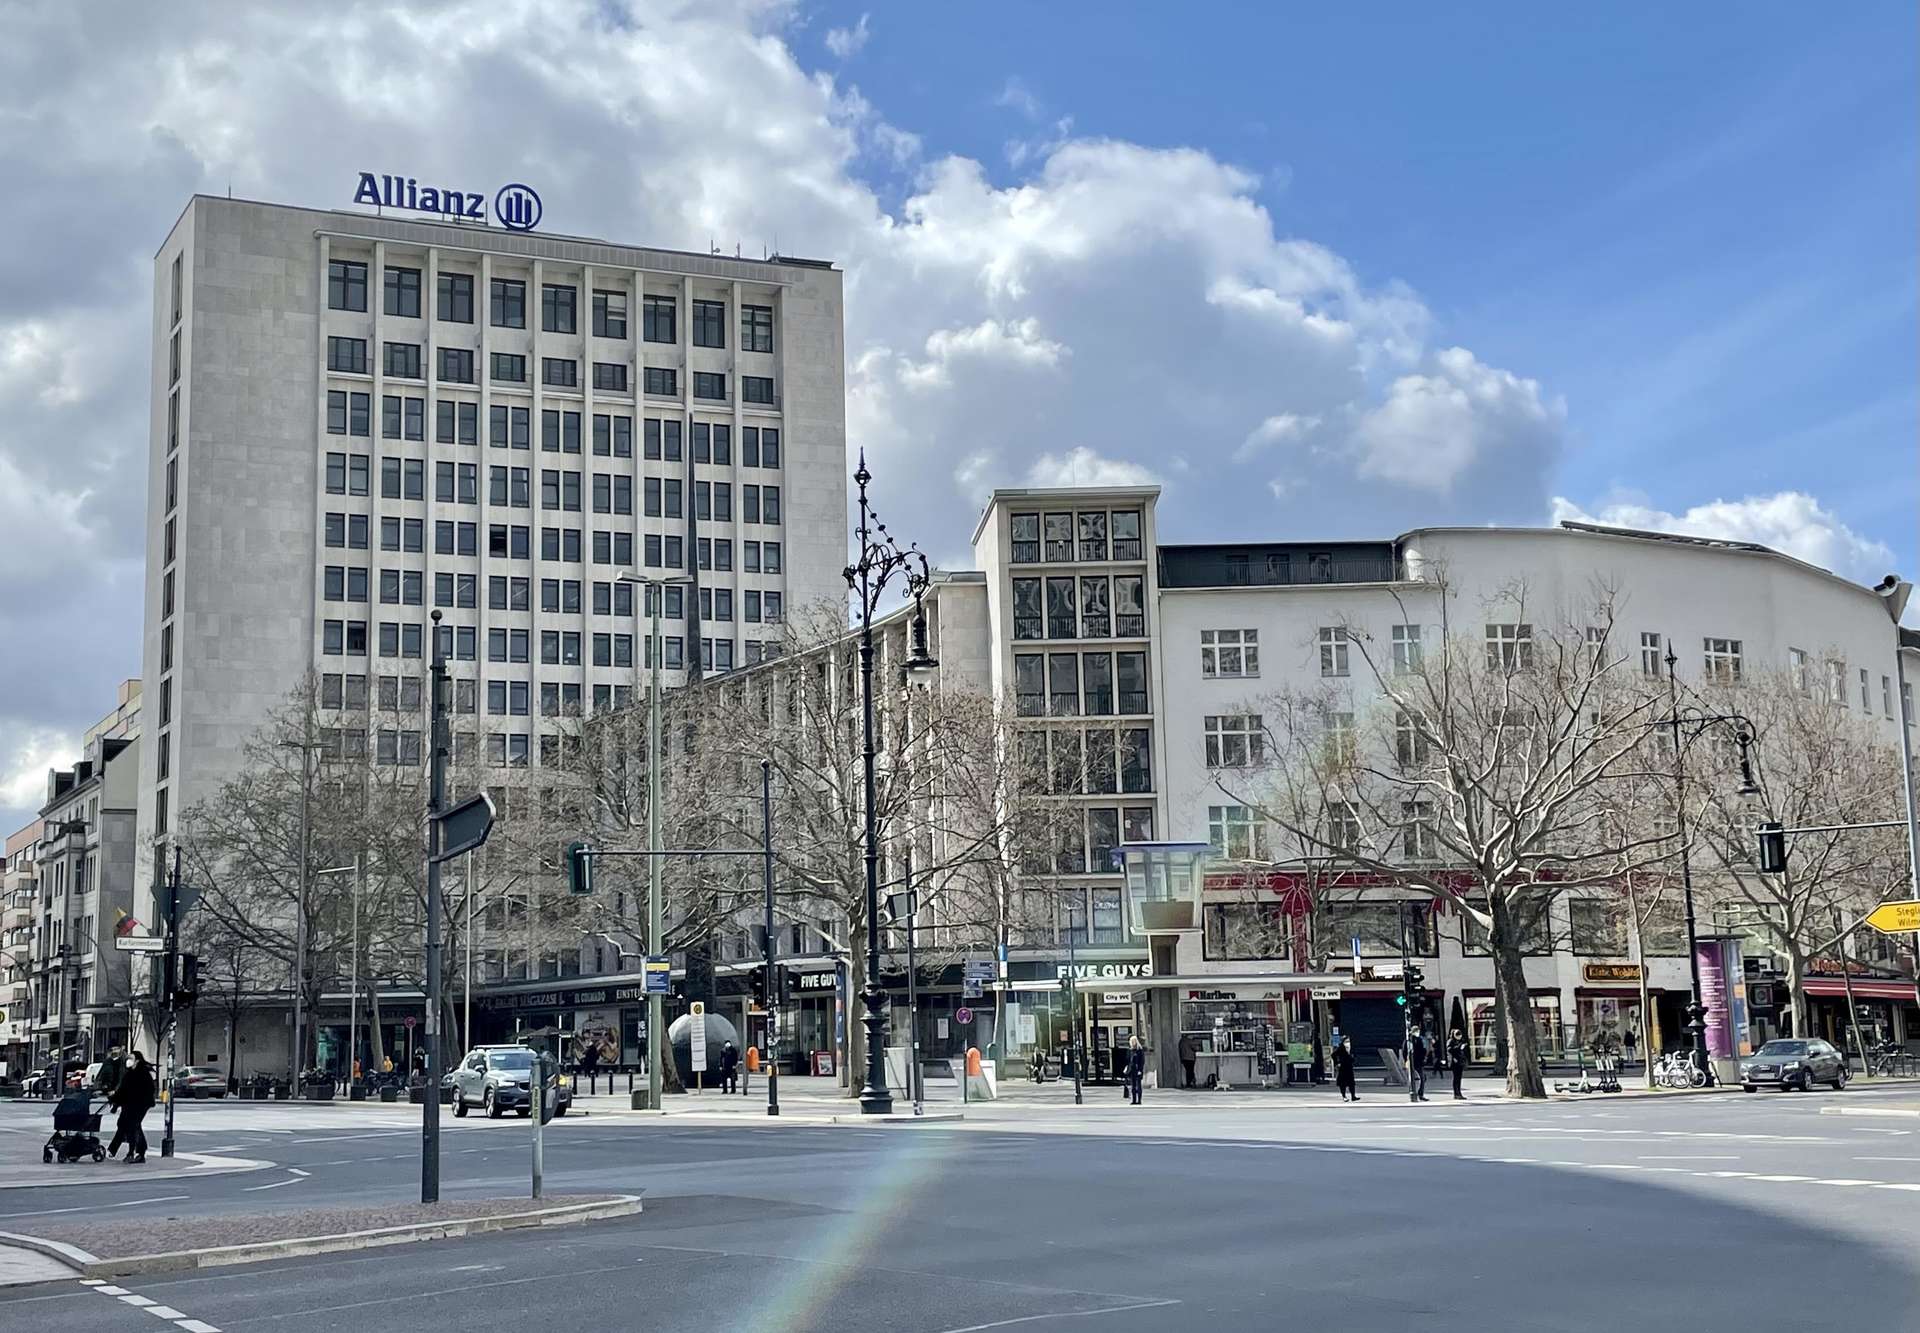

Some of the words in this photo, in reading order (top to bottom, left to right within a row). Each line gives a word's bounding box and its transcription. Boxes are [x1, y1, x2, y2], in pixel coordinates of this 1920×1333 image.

[354, 172, 484, 218] Allianz
[1897, 918, 1920, 927] Wilm
[1057, 965, 1098, 979] FIVE
[1102, 964, 1153, 977] GUYS
[801, 974, 819, 988] FIVE
[820, 973, 836, 987] GUY
[1200, 990, 1236, 1000] Marlboro
